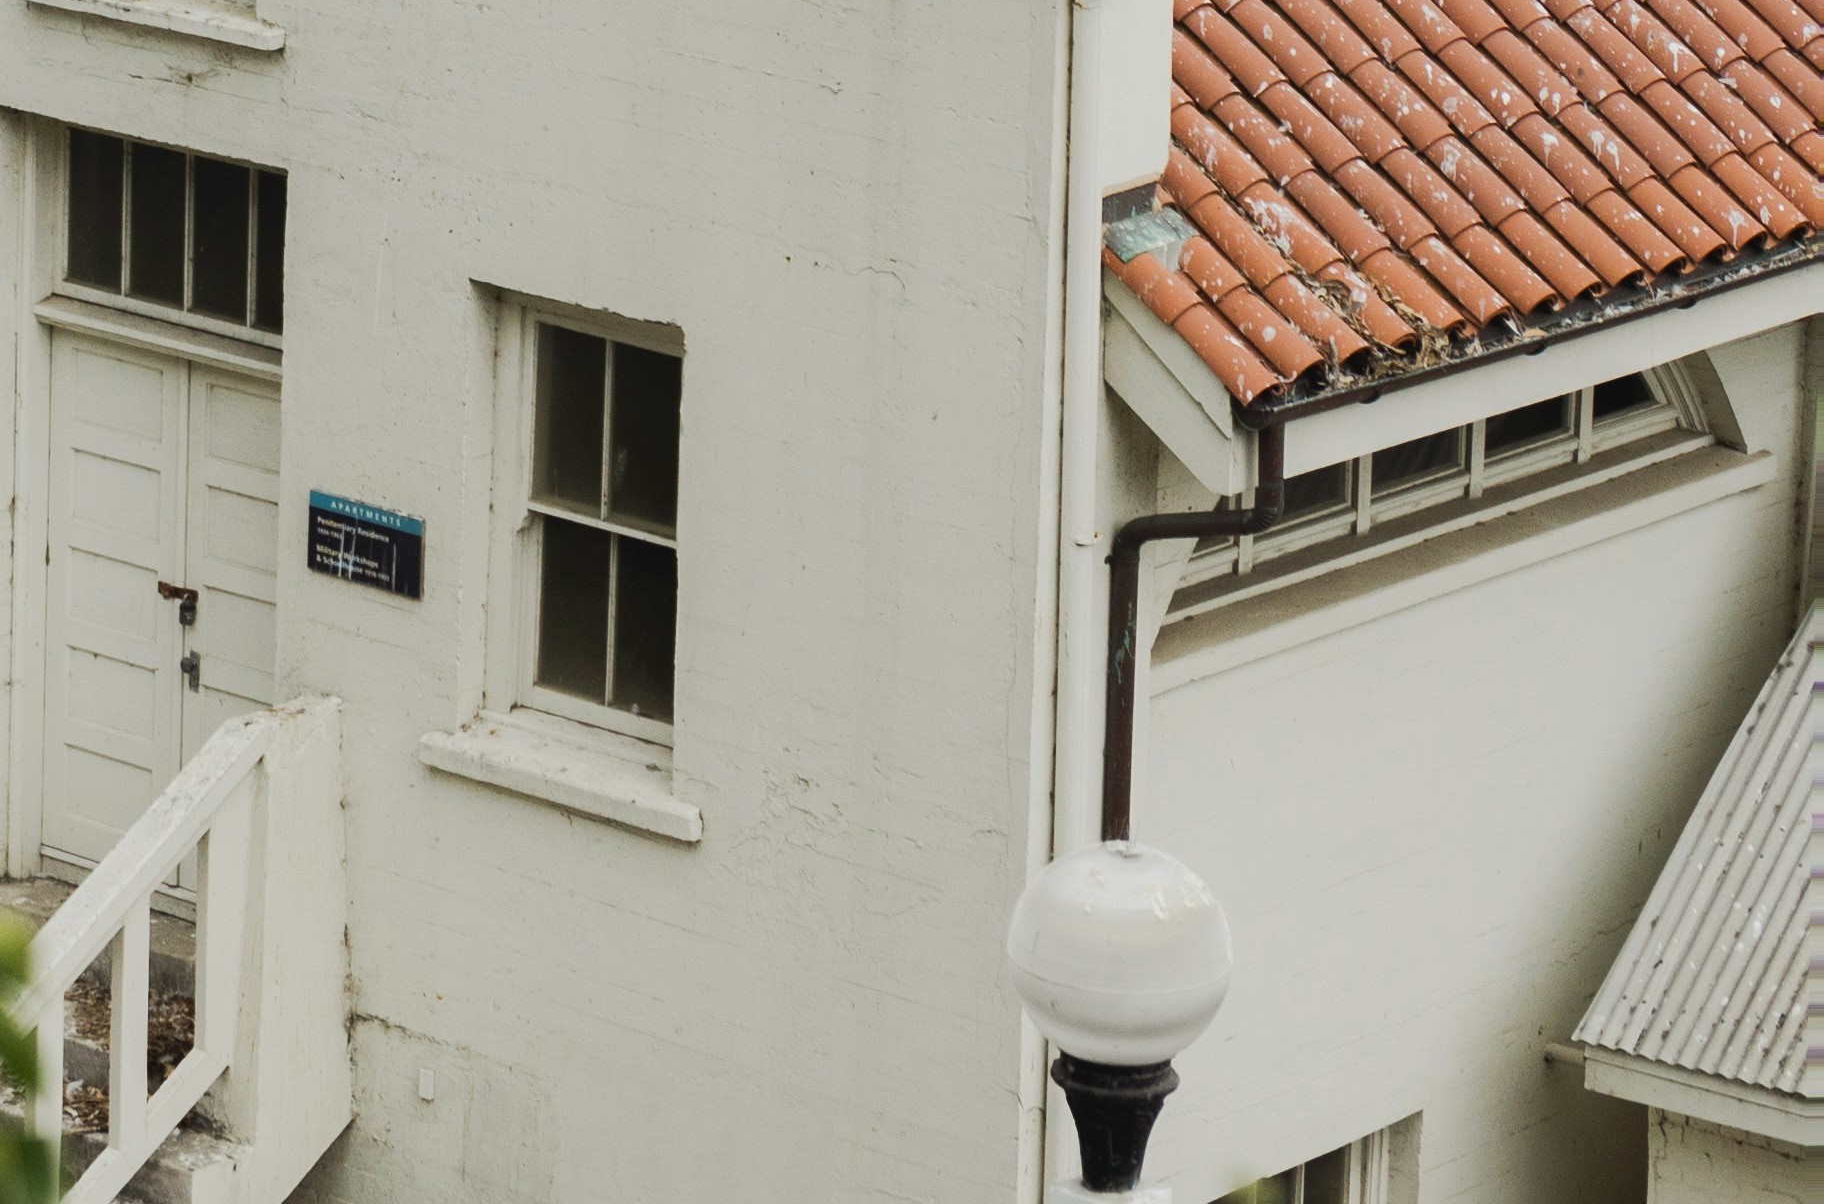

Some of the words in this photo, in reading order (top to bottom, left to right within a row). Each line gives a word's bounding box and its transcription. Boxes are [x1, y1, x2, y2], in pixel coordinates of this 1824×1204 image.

[331, 501, 401, 526] APARTMENTS
[317, 516, 356, 534] Penitentiary
[358, 527, 389, 543] Residence
[316, 544, 342, 558] Military
[343, 552, 378, 569] Workshops
